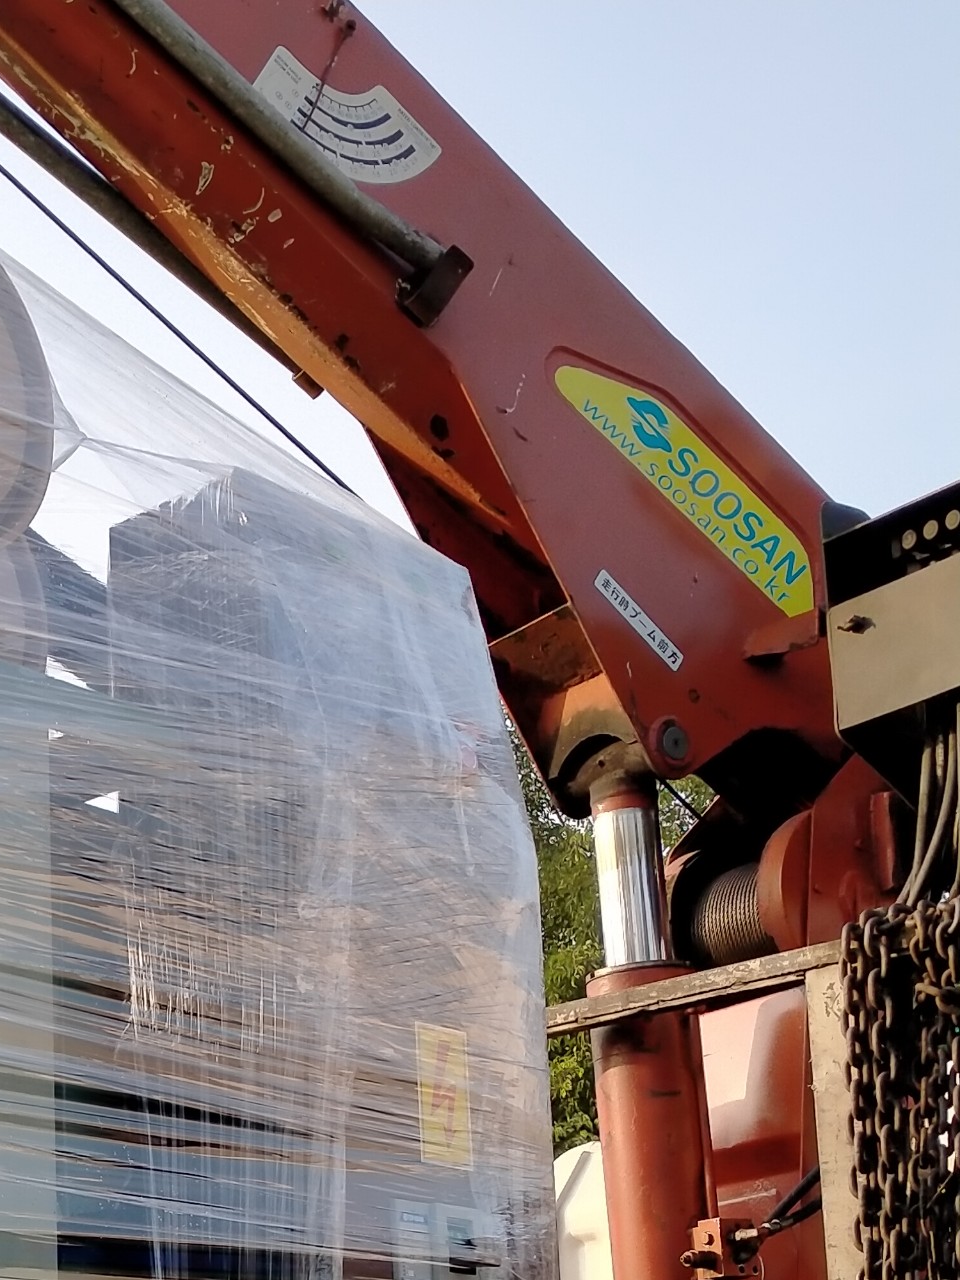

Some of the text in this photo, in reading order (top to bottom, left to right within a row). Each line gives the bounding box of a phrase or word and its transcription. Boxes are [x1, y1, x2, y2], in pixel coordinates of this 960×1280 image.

[583, 399, 790, 603] www.soosan.co.kr
[668, 447, 808, 585] SOOSAN
[600, 576, 682, 666] 走行時ブーム前方
